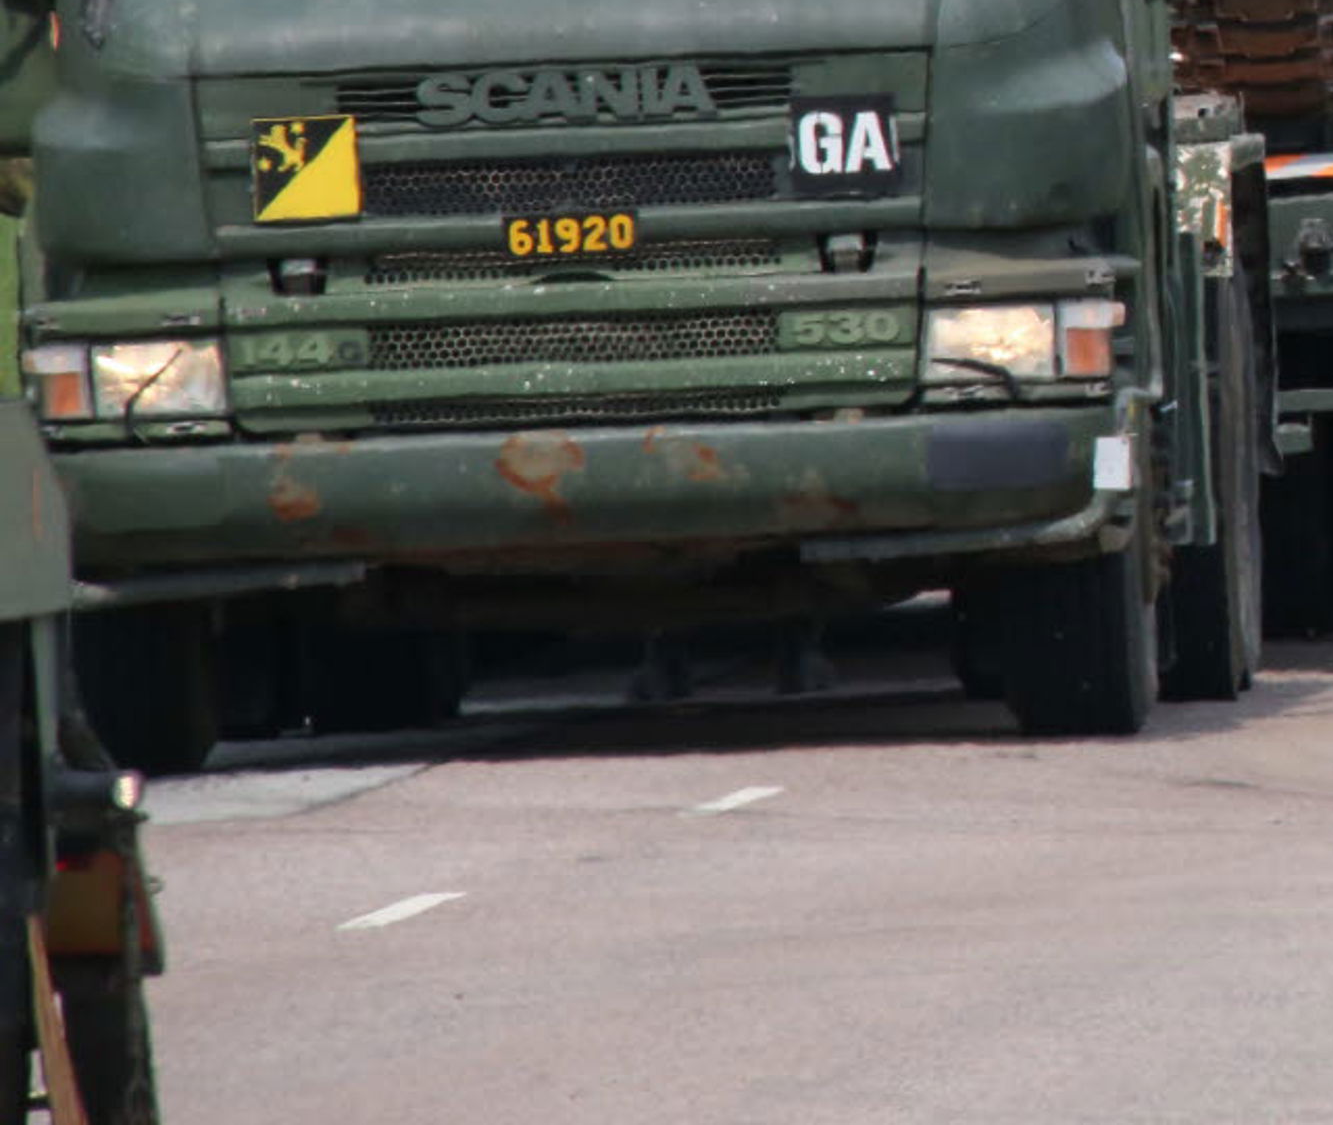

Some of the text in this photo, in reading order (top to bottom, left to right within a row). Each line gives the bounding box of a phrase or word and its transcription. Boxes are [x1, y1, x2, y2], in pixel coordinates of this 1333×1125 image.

[415, 63, 718, 127] SCANIA
[798, 110, 893, 176] GA
[508, 213, 635, 256] 61920
[792, 310, 900, 345] 530
